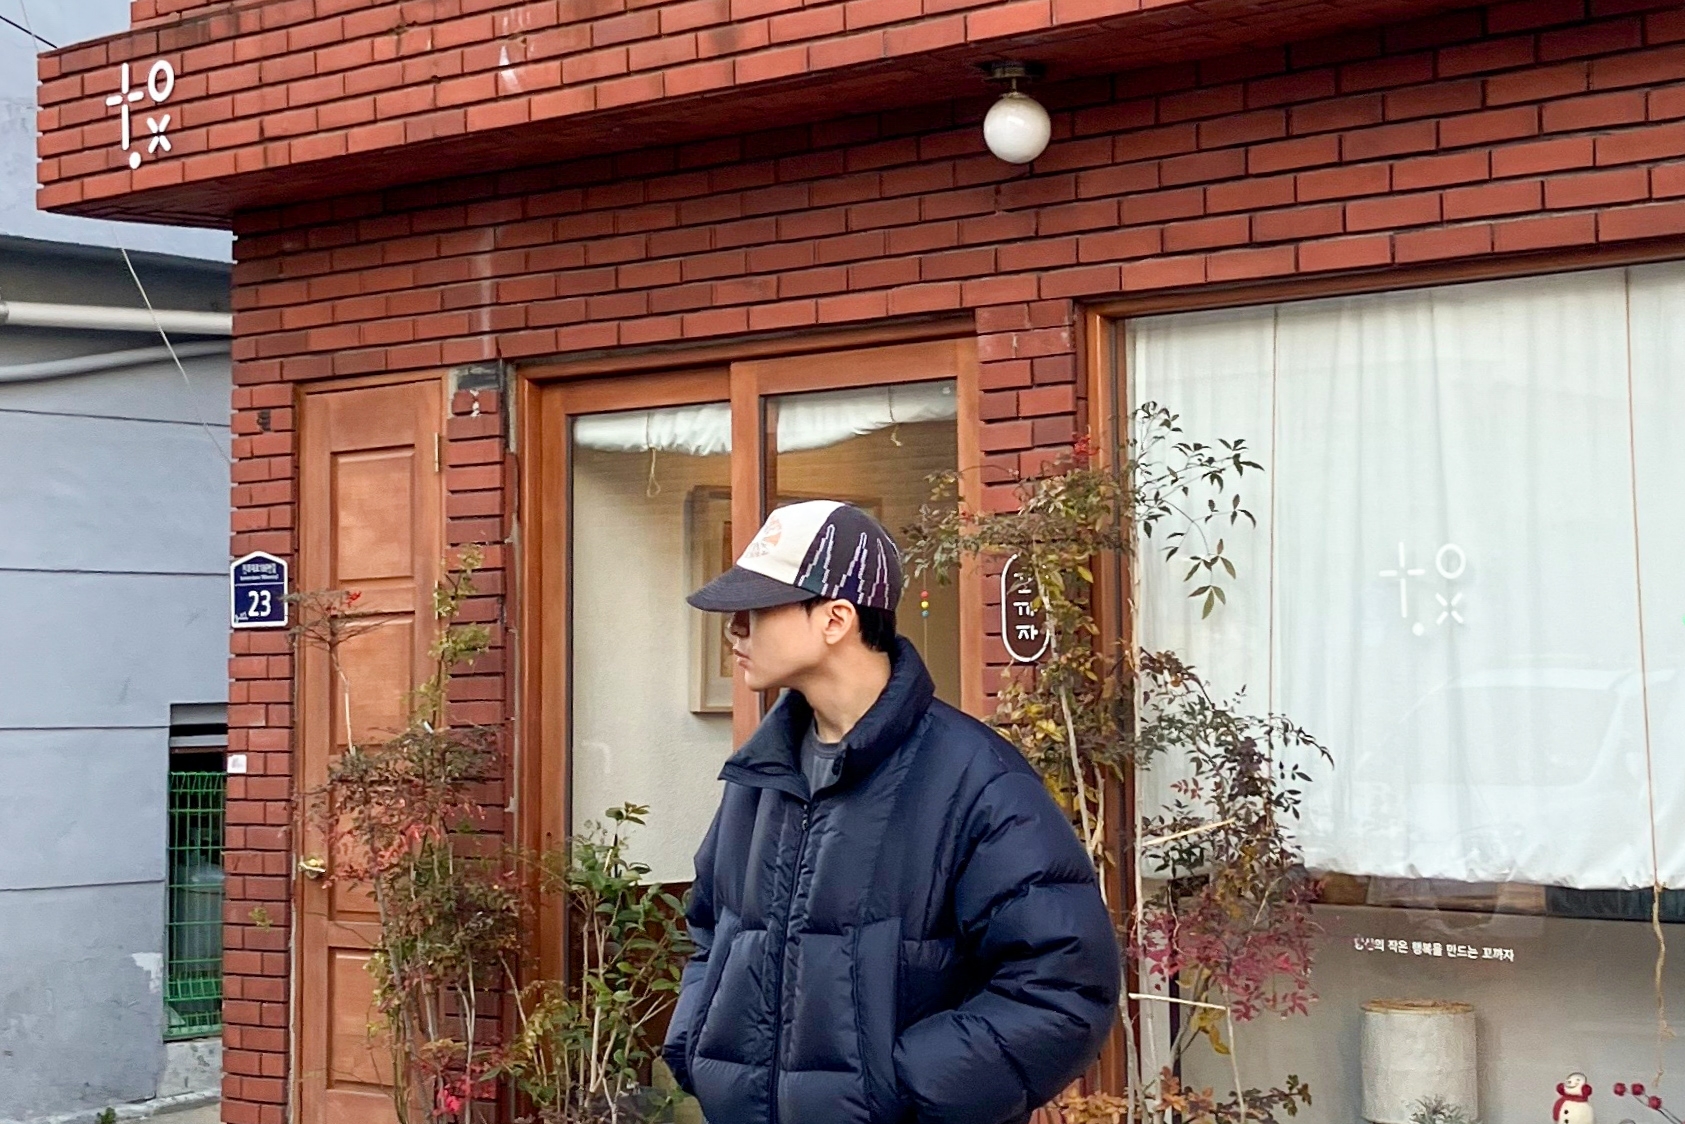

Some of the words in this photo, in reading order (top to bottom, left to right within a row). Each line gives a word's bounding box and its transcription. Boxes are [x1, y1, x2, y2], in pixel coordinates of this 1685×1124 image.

[248, 589, 272, 617] 23
[1387, 938, 1409, 954] 작은
[1411, 940, 1443, 957] 행복을
[1445, 943, 1479, 960] 만드는
